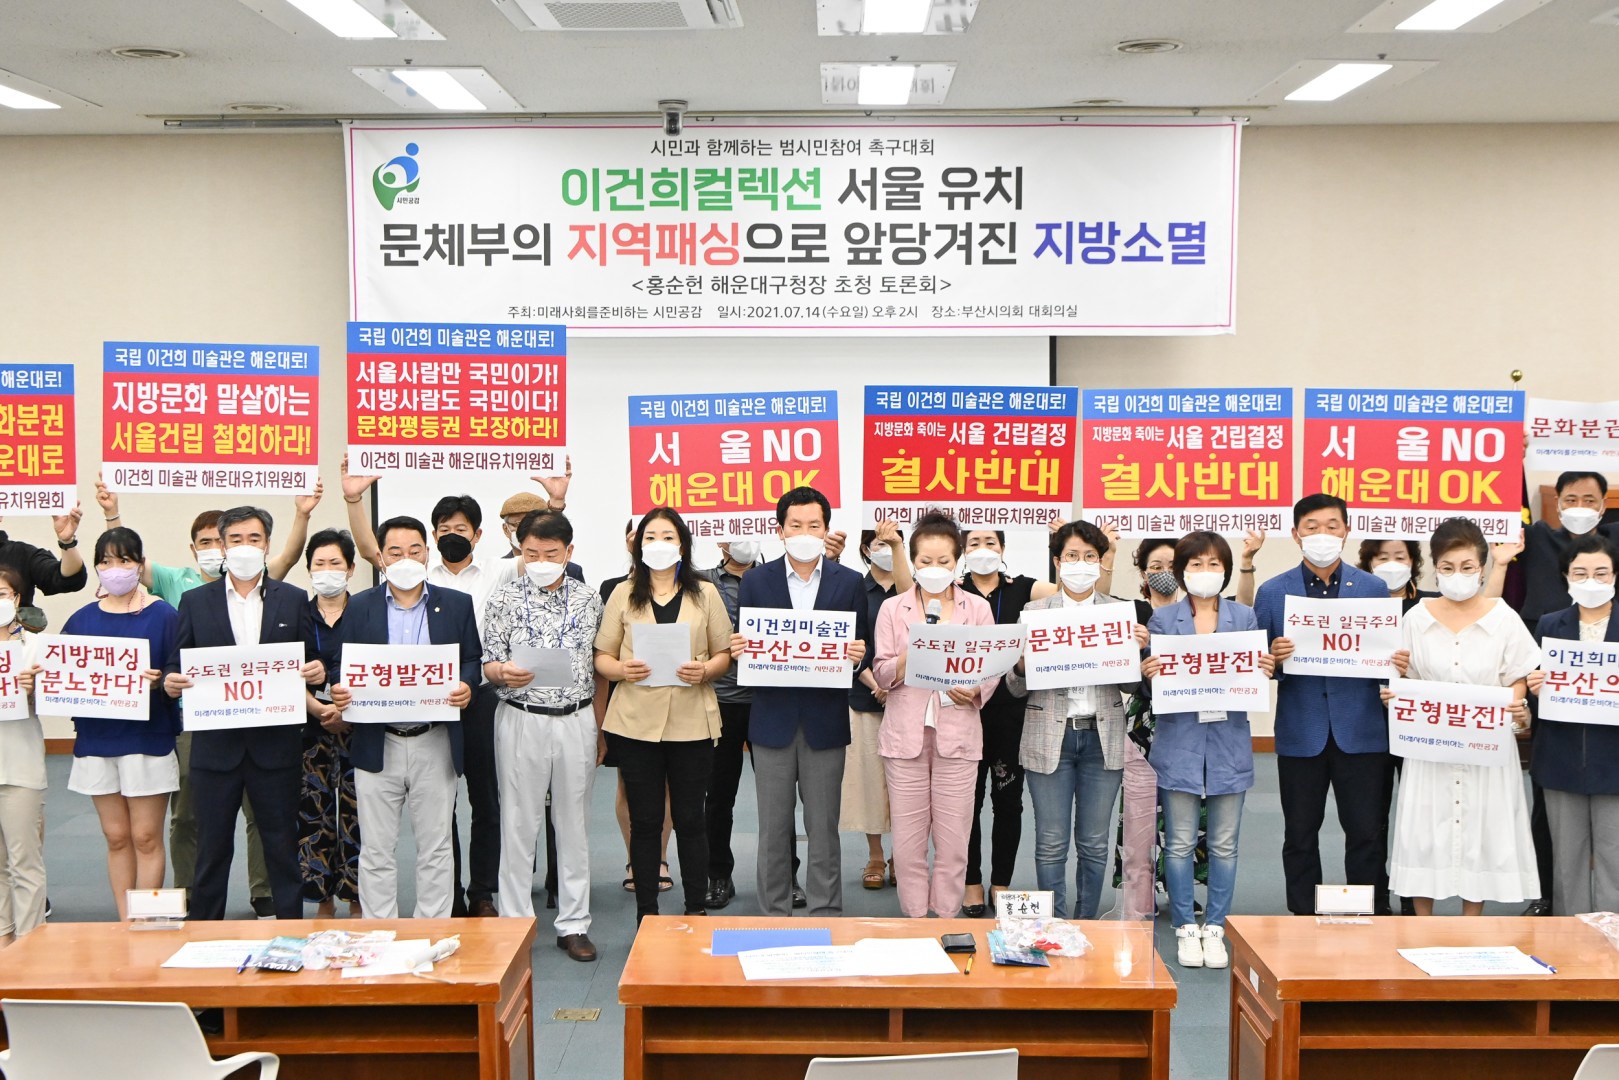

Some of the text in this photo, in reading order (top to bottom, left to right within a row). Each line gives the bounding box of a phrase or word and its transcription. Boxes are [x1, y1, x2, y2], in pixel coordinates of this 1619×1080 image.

[650, 138, 935, 158] 시민과 함께하는 범시민참여 촉구대회
[562, 166, 1024, 211] 이건희컬렉션 서울 유치
[396, 196, 420, 205] 시민공감
[380, 220, 1207, 267] 문체부의 지역패싱으로 앞당겨진 지방소멸
[711, 275, 827, 295] 해운대구청장
[834, 275, 872, 295] 초청
[880, 275, 952, 295] 토론회>
[653, 305, 703, 320] 시민공감
[872, 305, 897, 320] 오후
[899, 305, 919, 319] 2시
[931, 304, 1024, 319] 장소:부산시의회
[1028, 304, 1079, 319] 대회의실
[359, 327, 555, 348] 국립 이건희 미술관은 해운대로!
[115, 348, 308, 370] 국립 이건희 미술관은 해운대로!
[1, 370, 62, 389] 해운대로!
[355, 361, 559, 386] 서울사람만 국민이가!
[111, 381, 310, 417] 지방문화 말살하는
[356, 388, 559, 413] 지방사람도 국민이다!
[640, 396, 827, 419] 국립 이건희 미술관은 해운대로!
[875, 391, 1067, 411] 국립 이건희 미술관은 해운대로!
[1093, 393, 1282, 414] 국립 이건희 미술관은 해운대로!
[1316, 393, 1513, 414] 국립 이건희 미술관은 해운대로!
[356, 415, 559, 439] 문화평등권 보장하라!
[873, 421, 1067, 447] 지방문화 죽이는 서울 건립결정
[1092, 424, 1284, 450] 지방문화 죽이는 서울 건립결정
[110, 421, 312, 456] 서울건립 철회하라!
[762, 427, 822, 463] NO
[1441, 427, 1506, 463] NO
[361, 451, 554, 471] 이건희 미술관 해운대유치위원회
[114, 468, 307, 489] 이건희 미술관 해운대유치위원회
[880, 450, 1061, 496] 결사반대
[1100, 455, 1279, 501] 결사반대
[649, 471, 754, 508] 해운대
[1321, 466, 1503, 505] 해운대 OK
[874, 507, 912, 524] 이건희
[958, 507, 1061, 525] 해운대유치위원회
[1095, 513, 1282, 532] 이건희 미술관 해운대유치위원회
[1357, 515, 1397, 533] 미술관
[687, 518, 725, 537] 미술관
[746, 618, 851, 638] 이건희미술관
[1288, 613, 1397, 630] 수도권 일극주의
[912, 637, 1021, 653] 수도권 일극주의
[1028, 620, 1133, 653] 문화분권!
[1322, 632, 1361, 652] NO!
[45, 644, 139, 671] 지방패싱
[743, 639, 849, 663] 부산으로!
[185, 659, 300, 679] 수도권 일극주의
[346, 662, 453, 688] 균형발전!
[945, 656, 983, 674] NO!
[41, 670, 144, 697] 분노한다!
[224, 680, 263, 702] NO!
[1394, 698, 1506, 731] 균형발전!
